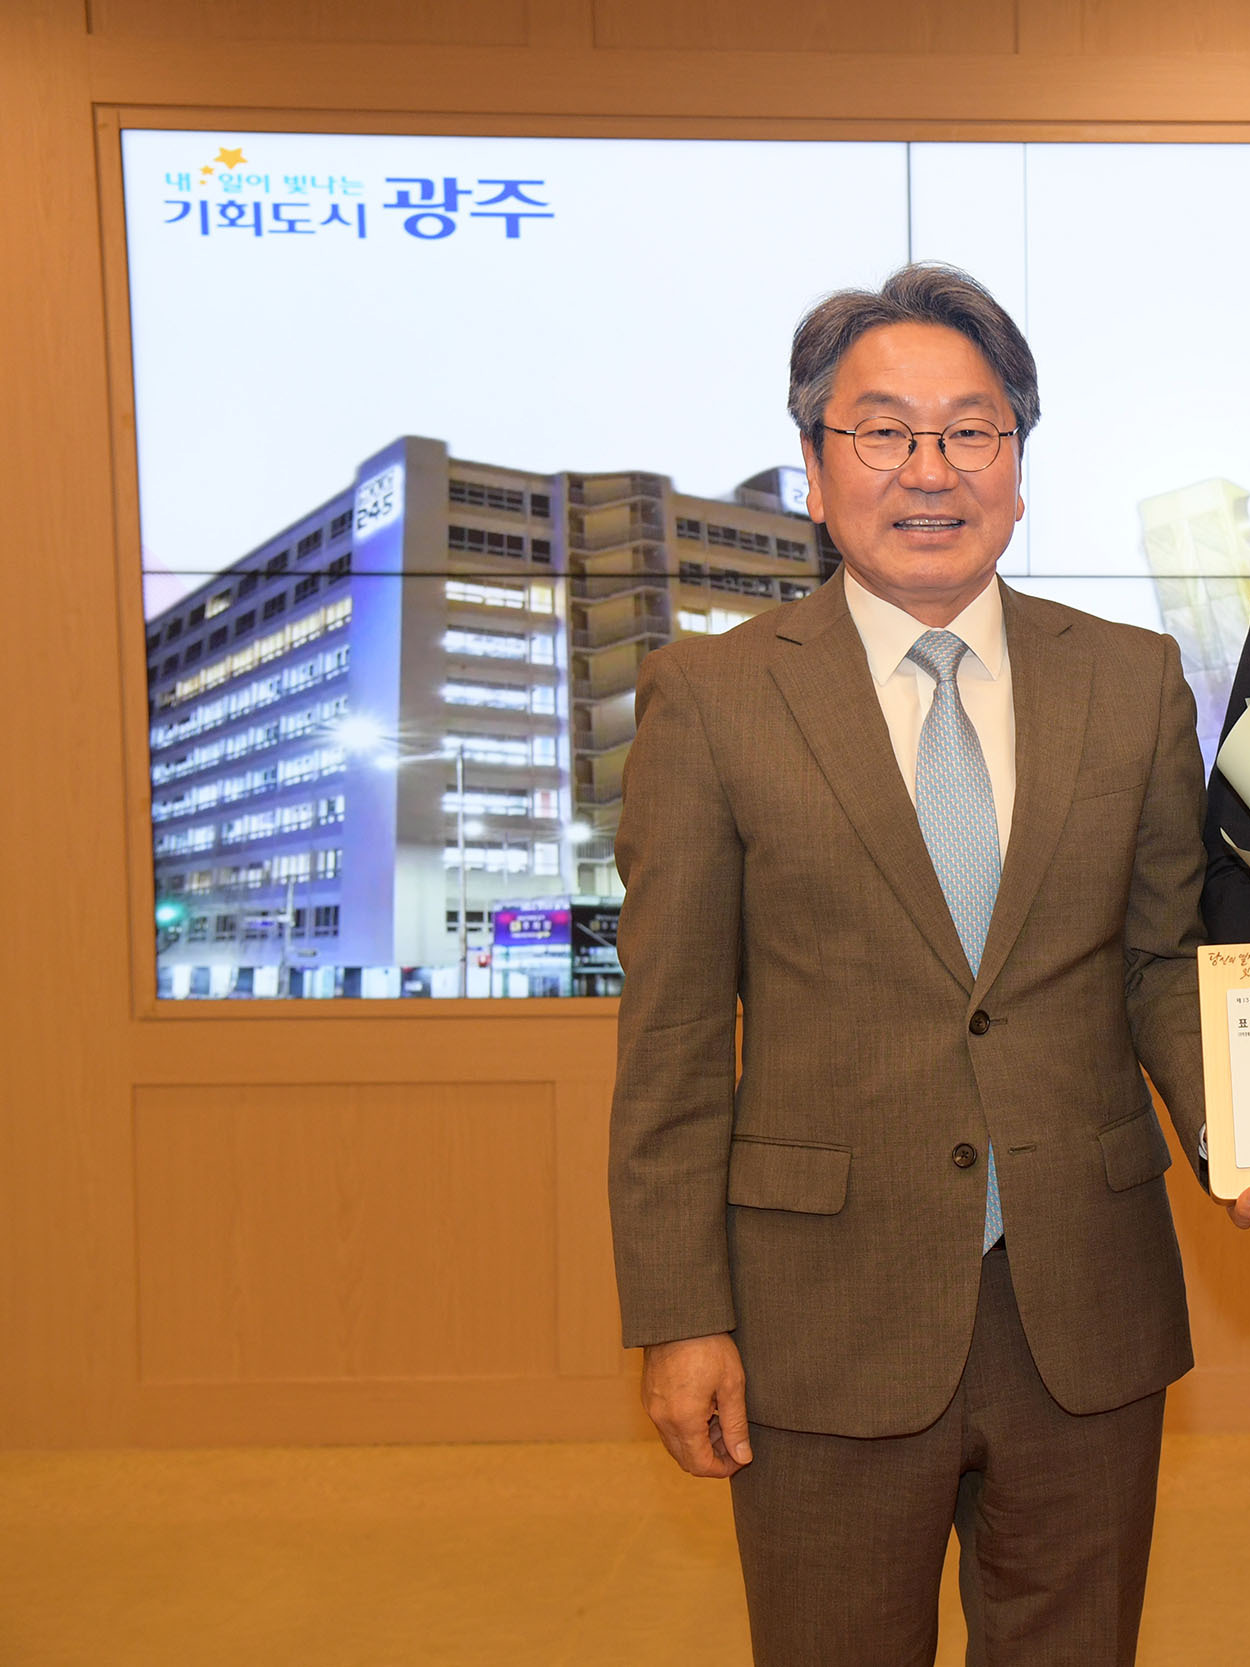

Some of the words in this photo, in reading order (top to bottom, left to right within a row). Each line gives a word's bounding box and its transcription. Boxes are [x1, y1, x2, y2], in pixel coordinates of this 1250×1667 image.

[165, 172, 191, 193] 내
[218, 173, 270, 194] 일이
[284, 174, 365, 197] 빛나는
[164, 199, 367, 239] 기회도시
[383, 177, 555, 240] 광주
